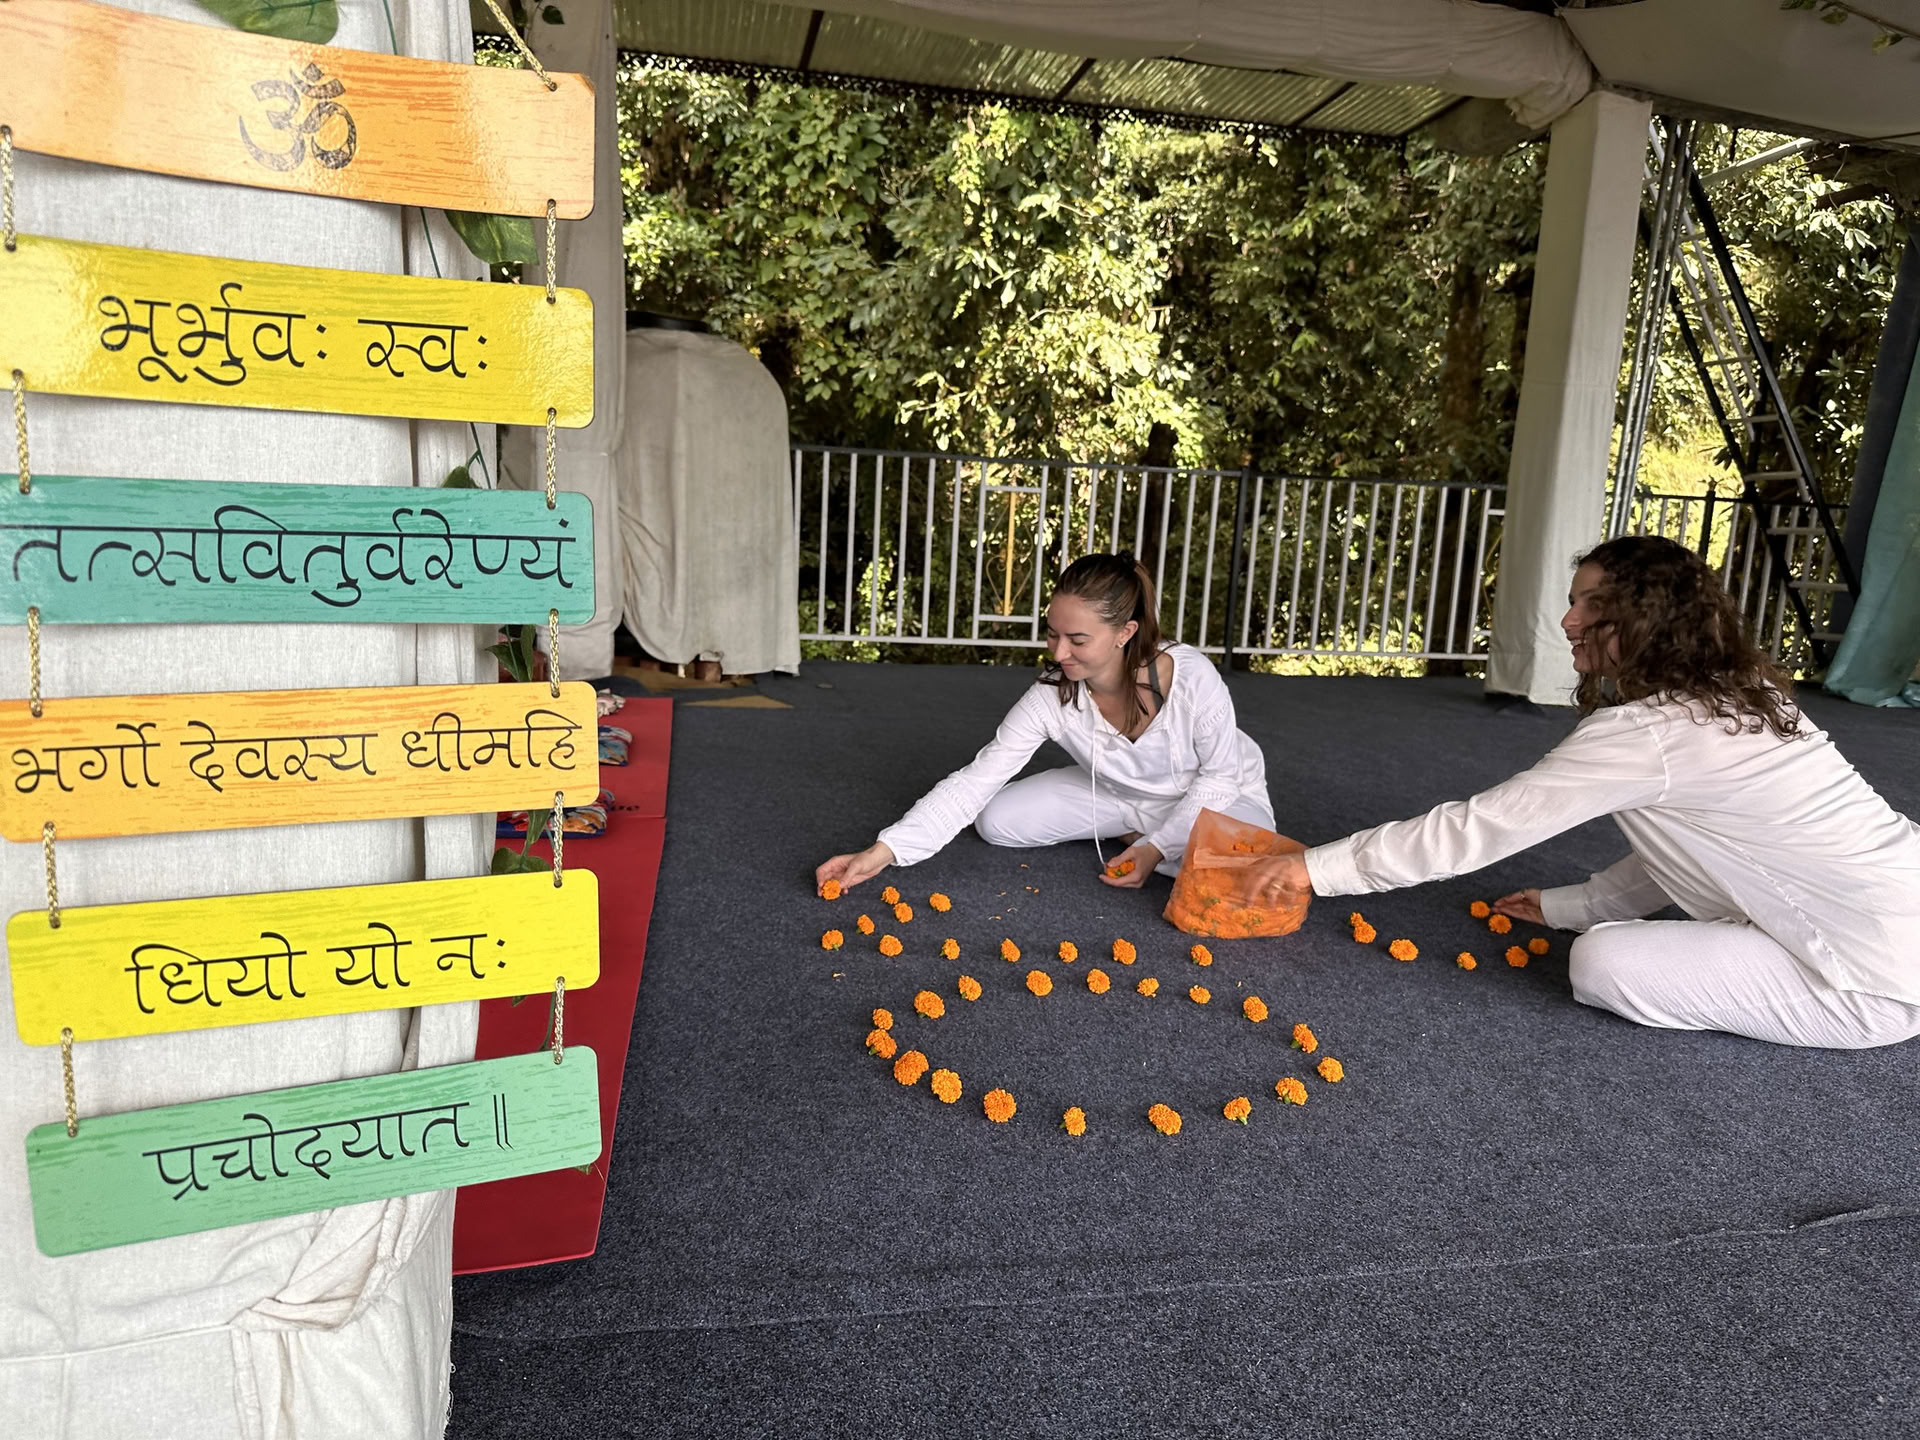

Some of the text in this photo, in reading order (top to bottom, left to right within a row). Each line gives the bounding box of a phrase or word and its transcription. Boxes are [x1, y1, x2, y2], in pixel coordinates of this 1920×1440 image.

[98, 282, 488, 386] भूर्भुवः स्वः
[0, 504, 577, 607] तत्सवितुर्वरेण्यं
[11, 711, 583, 793] भर्गो देवस्य धीमहि
[125, 922, 507, 1014] धियो यो नः
